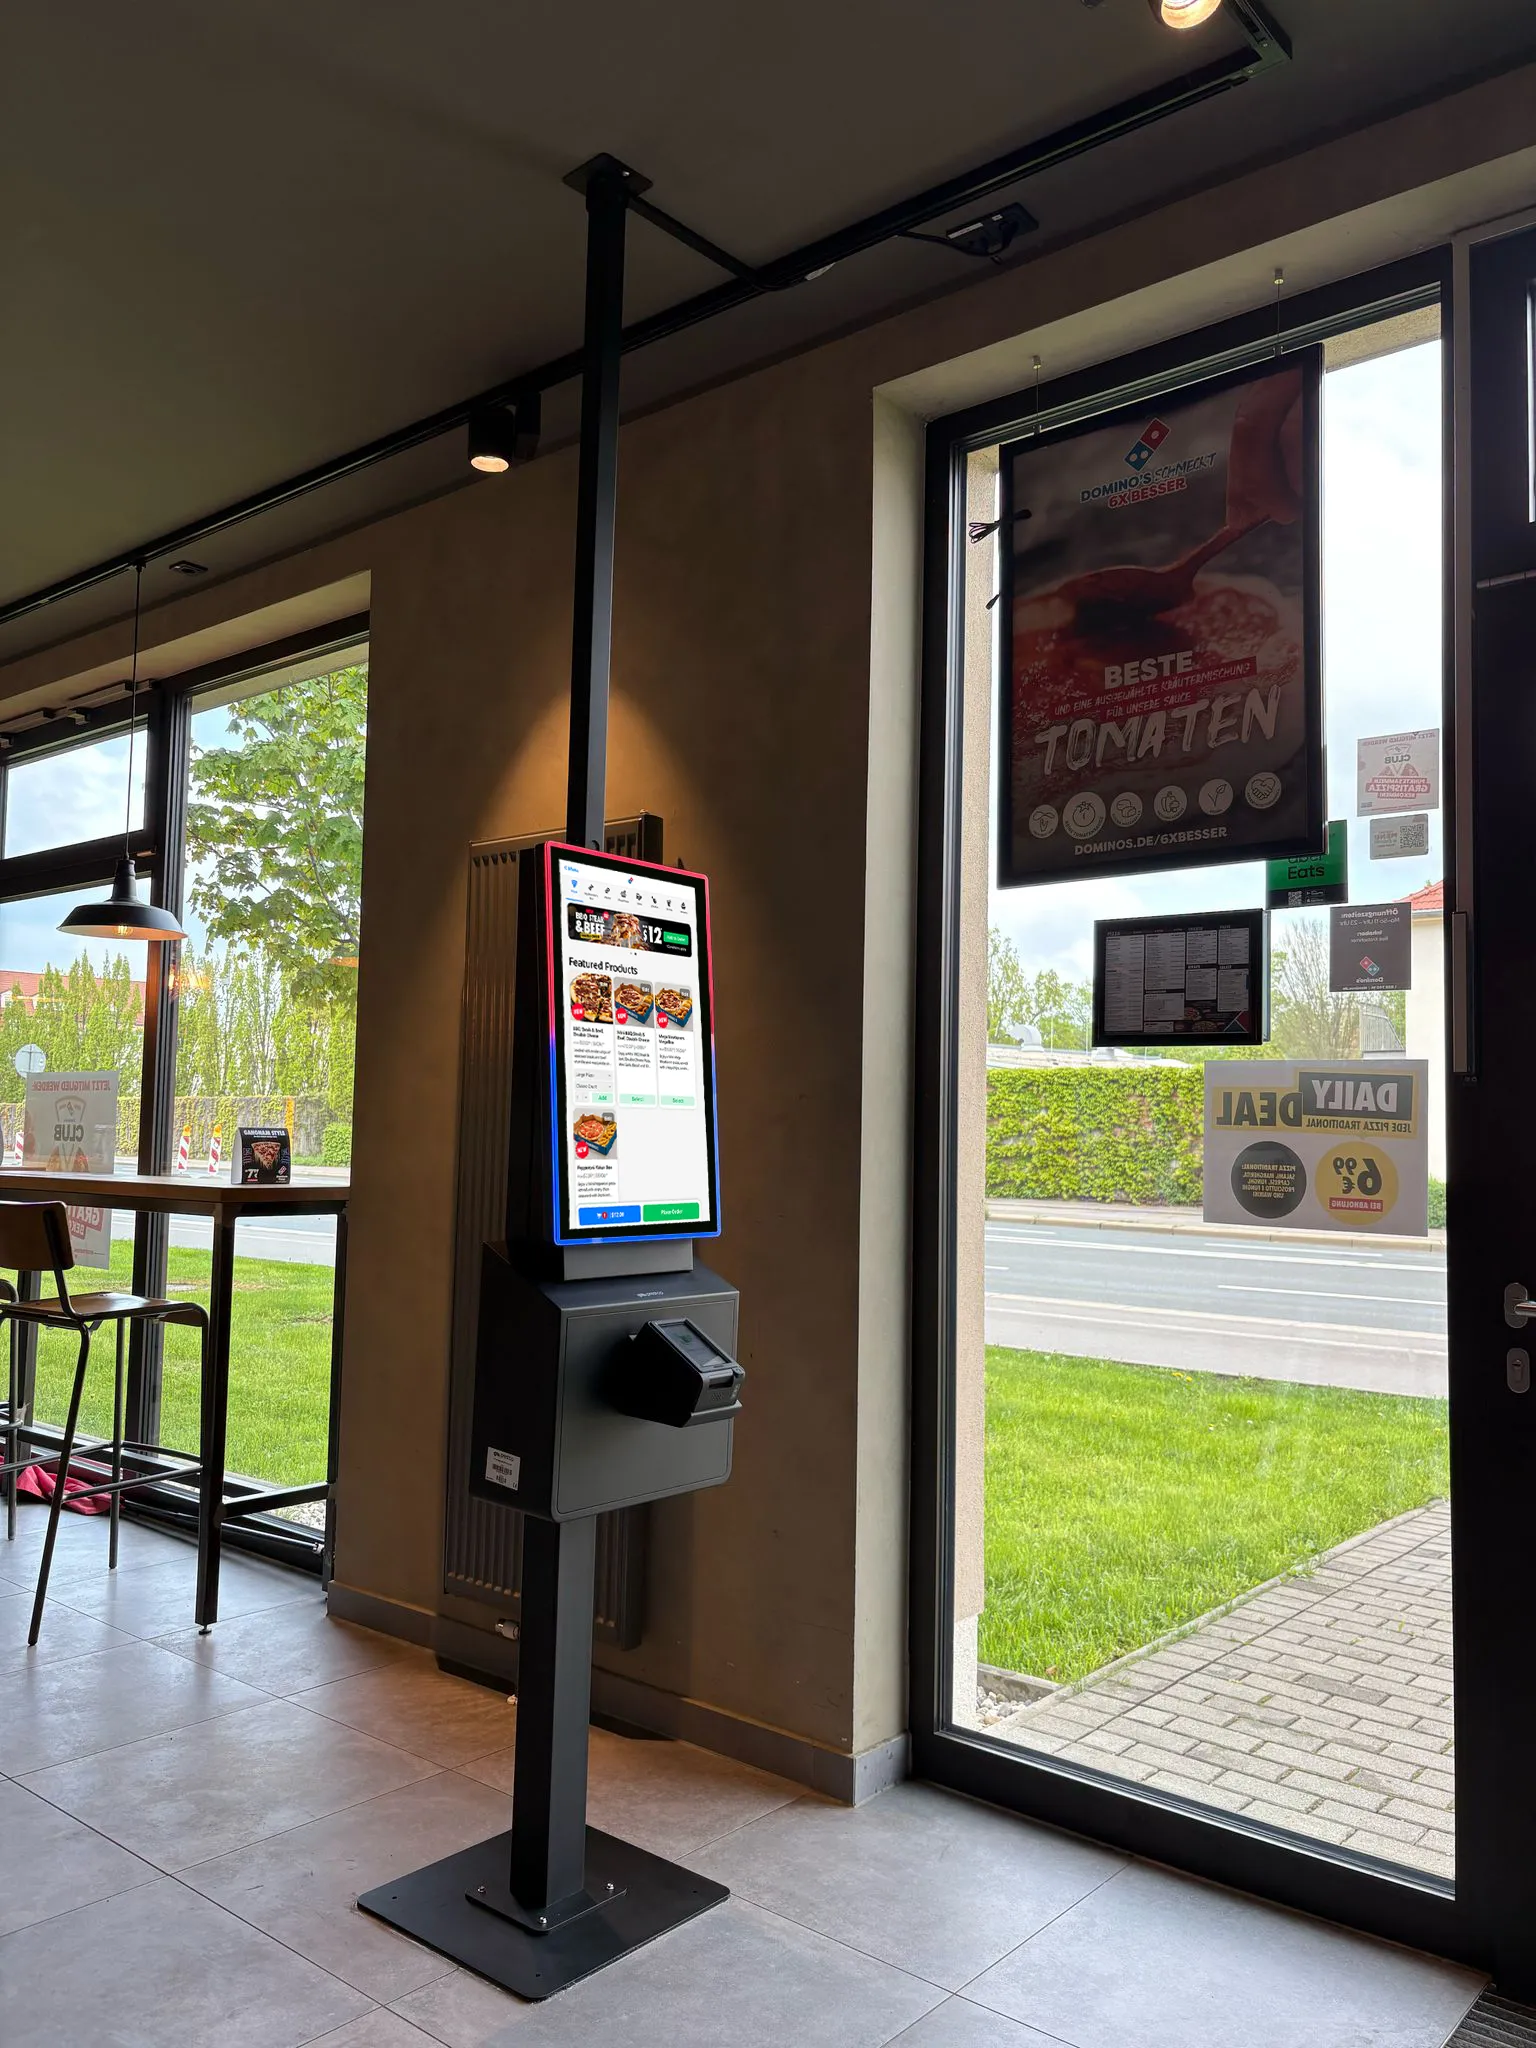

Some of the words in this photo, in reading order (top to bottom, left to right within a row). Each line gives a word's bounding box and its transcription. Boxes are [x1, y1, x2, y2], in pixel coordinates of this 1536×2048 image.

[1080, 472, 1152, 503] DOMINO'S
[1154, 452, 1217, 481] SCHMECKT
[1108, 493, 1130, 508] 6X
[1131, 477, 1187, 503] BESSER
[1104, 651, 1193, 690] BESTE
[1054, 703, 1071, 716] UND
[1073, 698, 1093, 712] EINE
[1106, 706, 1124, 720] FÜR
[1126, 698, 1161, 714] UNSERE
[1163, 691, 1192, 706] SAUCE
[1035, 684, 1281, 776] TOMATEN
[1074, 826, 1228, 856] DOMINOS.DE/6XBESSER
[1287, 865, 1325, 881] Eats
[569, 956, 603, 971] Featured
[604, 962, 639, 976] Products
